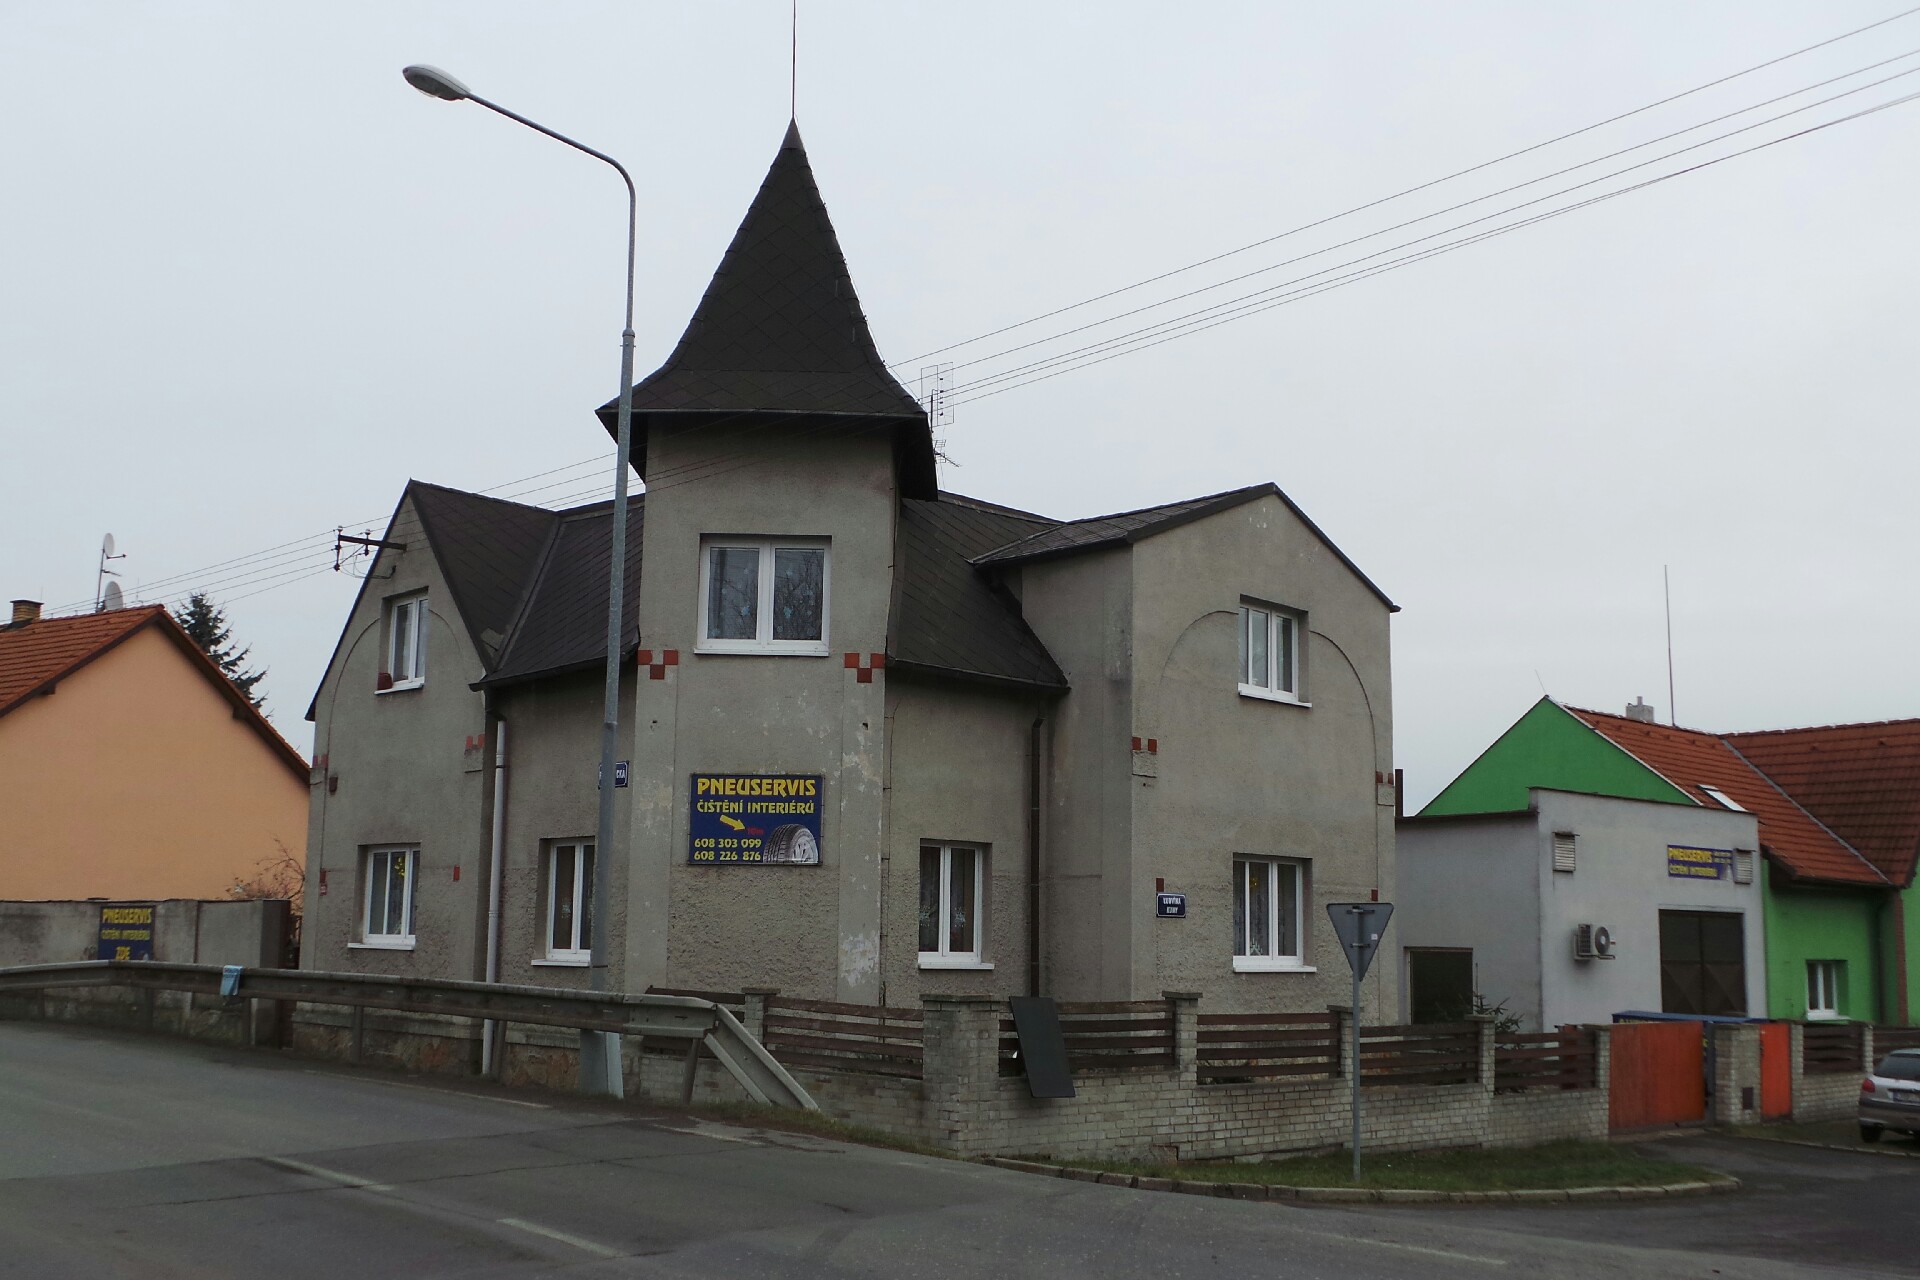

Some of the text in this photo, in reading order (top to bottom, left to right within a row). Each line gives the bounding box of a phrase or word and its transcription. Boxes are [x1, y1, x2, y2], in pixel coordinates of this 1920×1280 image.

[697, 778, 816, 797] PNEUSERVIS
[697, 800, 814, 814] ČIŠTĚNÍ INTERIÉRŮ
[694, 838, 761, 848] 608 303 099
[694, 850, 761, 861] 608 226 876
